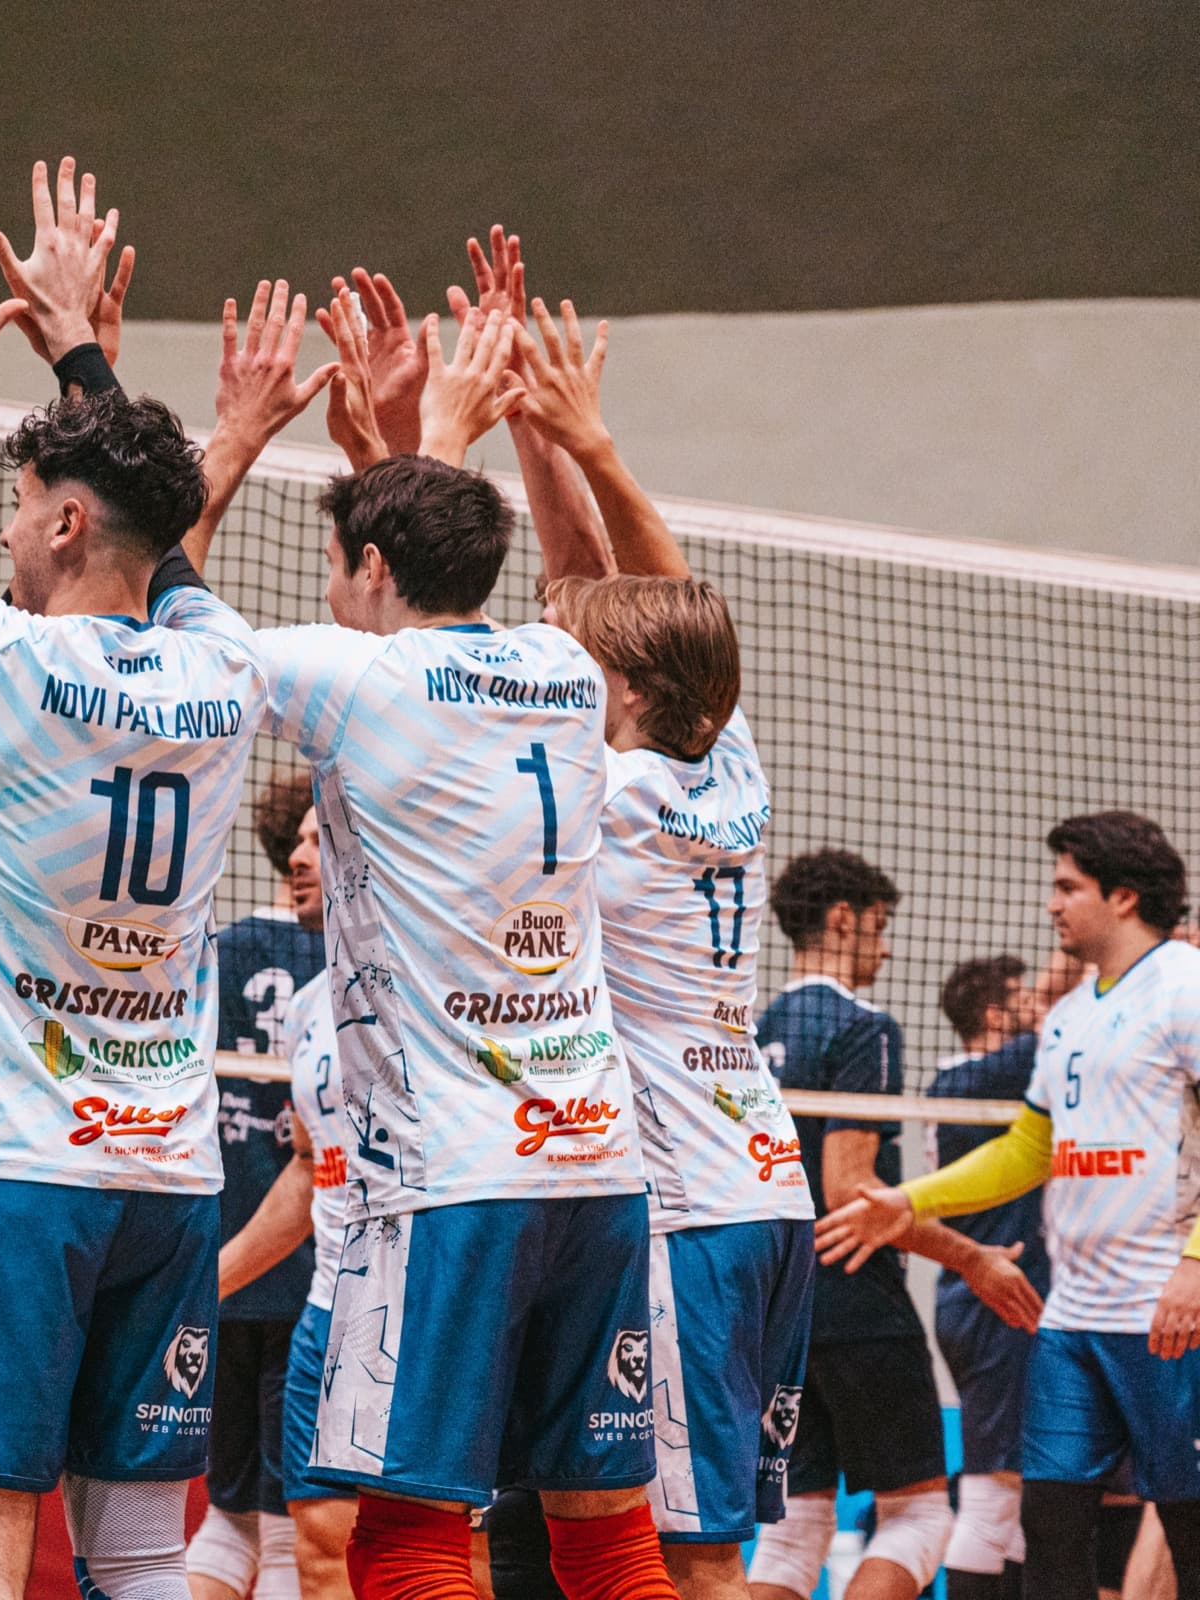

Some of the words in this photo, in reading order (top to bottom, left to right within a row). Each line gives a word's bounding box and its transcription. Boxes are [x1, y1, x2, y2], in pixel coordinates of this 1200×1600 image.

[40, 673, 107, 726] NOVI
[115, 691, 242, 739] PALLAVOLO
[425, 667, 486, 705] NOVI
[487, 675, 597, 710] PALLAVOLO
[515, 742, 558, 875] 1
[90, 766, 190, 907] 10
[521, 910, 564, 930] Buon
[81, 922, 165, 958] PANE
[503, 931, 571, 958] PANE
[15, 972, 188, 1022] GRISSITALIA
[444, 986, 598, 1025] GRISSITALI
[89, 1036, 198, 1068] AGRICOM
[316, 1054, 335, 1116] 2
[1065, 1052, 1084, 1109] 5
[136, 1403, 212, 1424] SPINOTTO
[140, 1424, 169, 1434] WEB
[176, 1427, 208, 1436] AGENC
[588, 1408, 655, 1429] SPINOO
[593, 1432, 623, 1441] WEB
